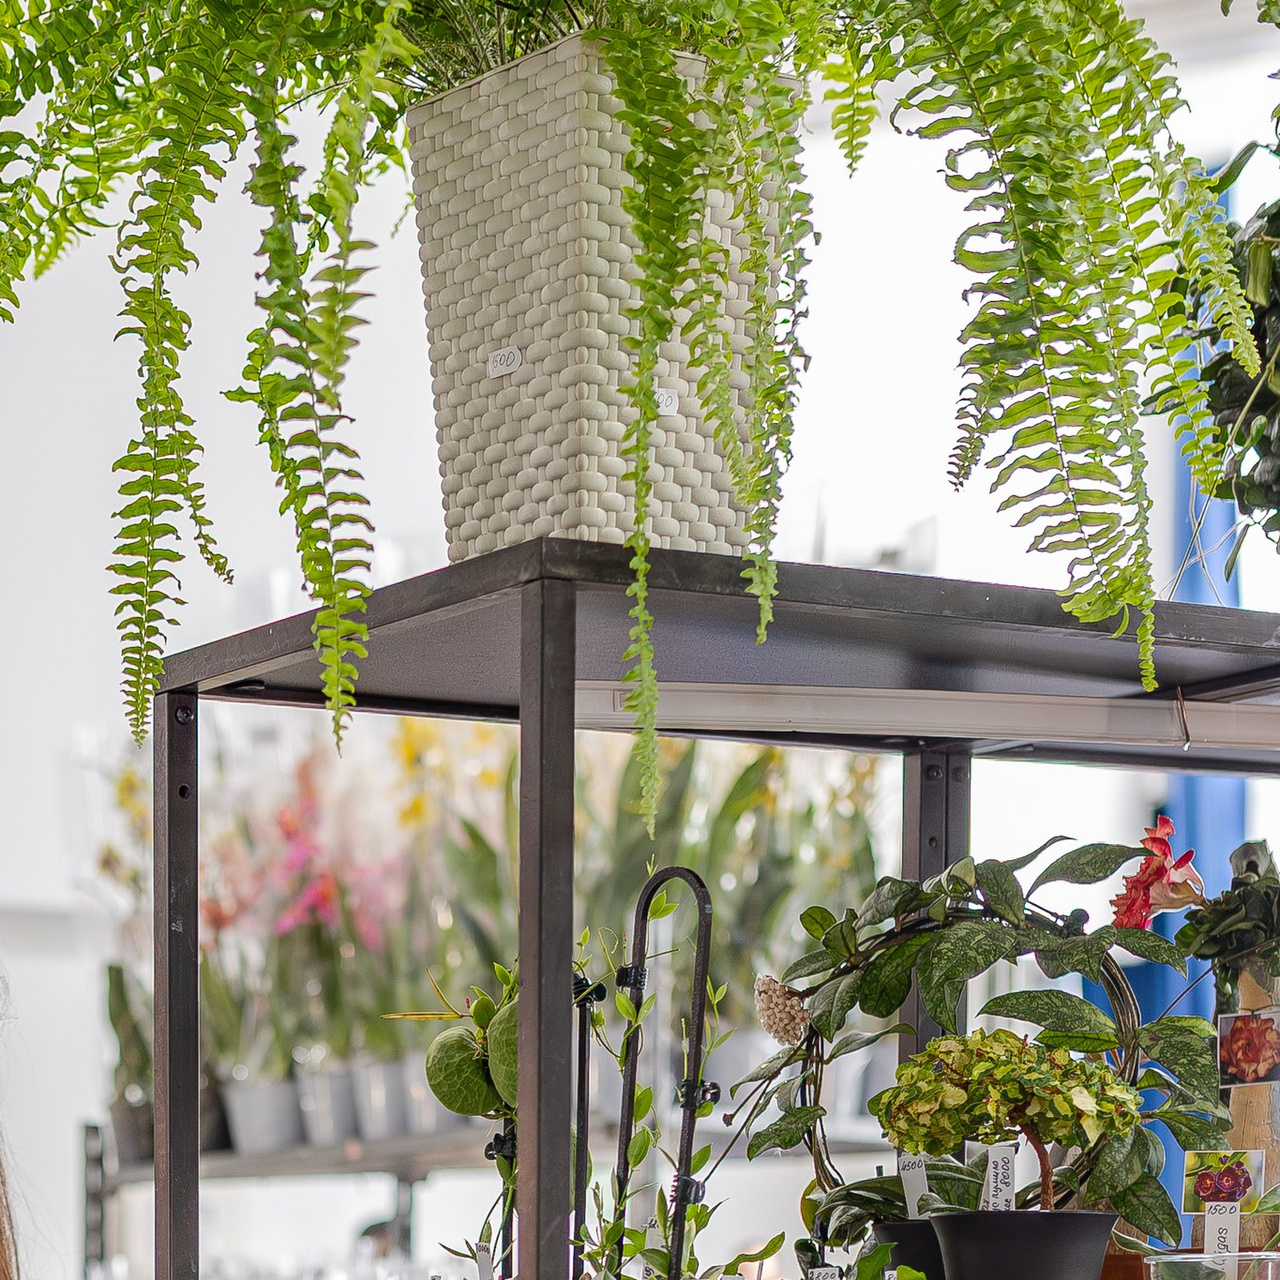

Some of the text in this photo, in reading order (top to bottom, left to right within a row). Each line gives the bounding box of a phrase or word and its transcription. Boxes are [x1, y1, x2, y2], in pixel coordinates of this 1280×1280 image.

[655, 393, 673, 408] 00
[901, 1160, 924, 1171] 4500
[1000, 1157, 1011, 1187] 8000
[1207, 1205, 1237, 1215] 1500
